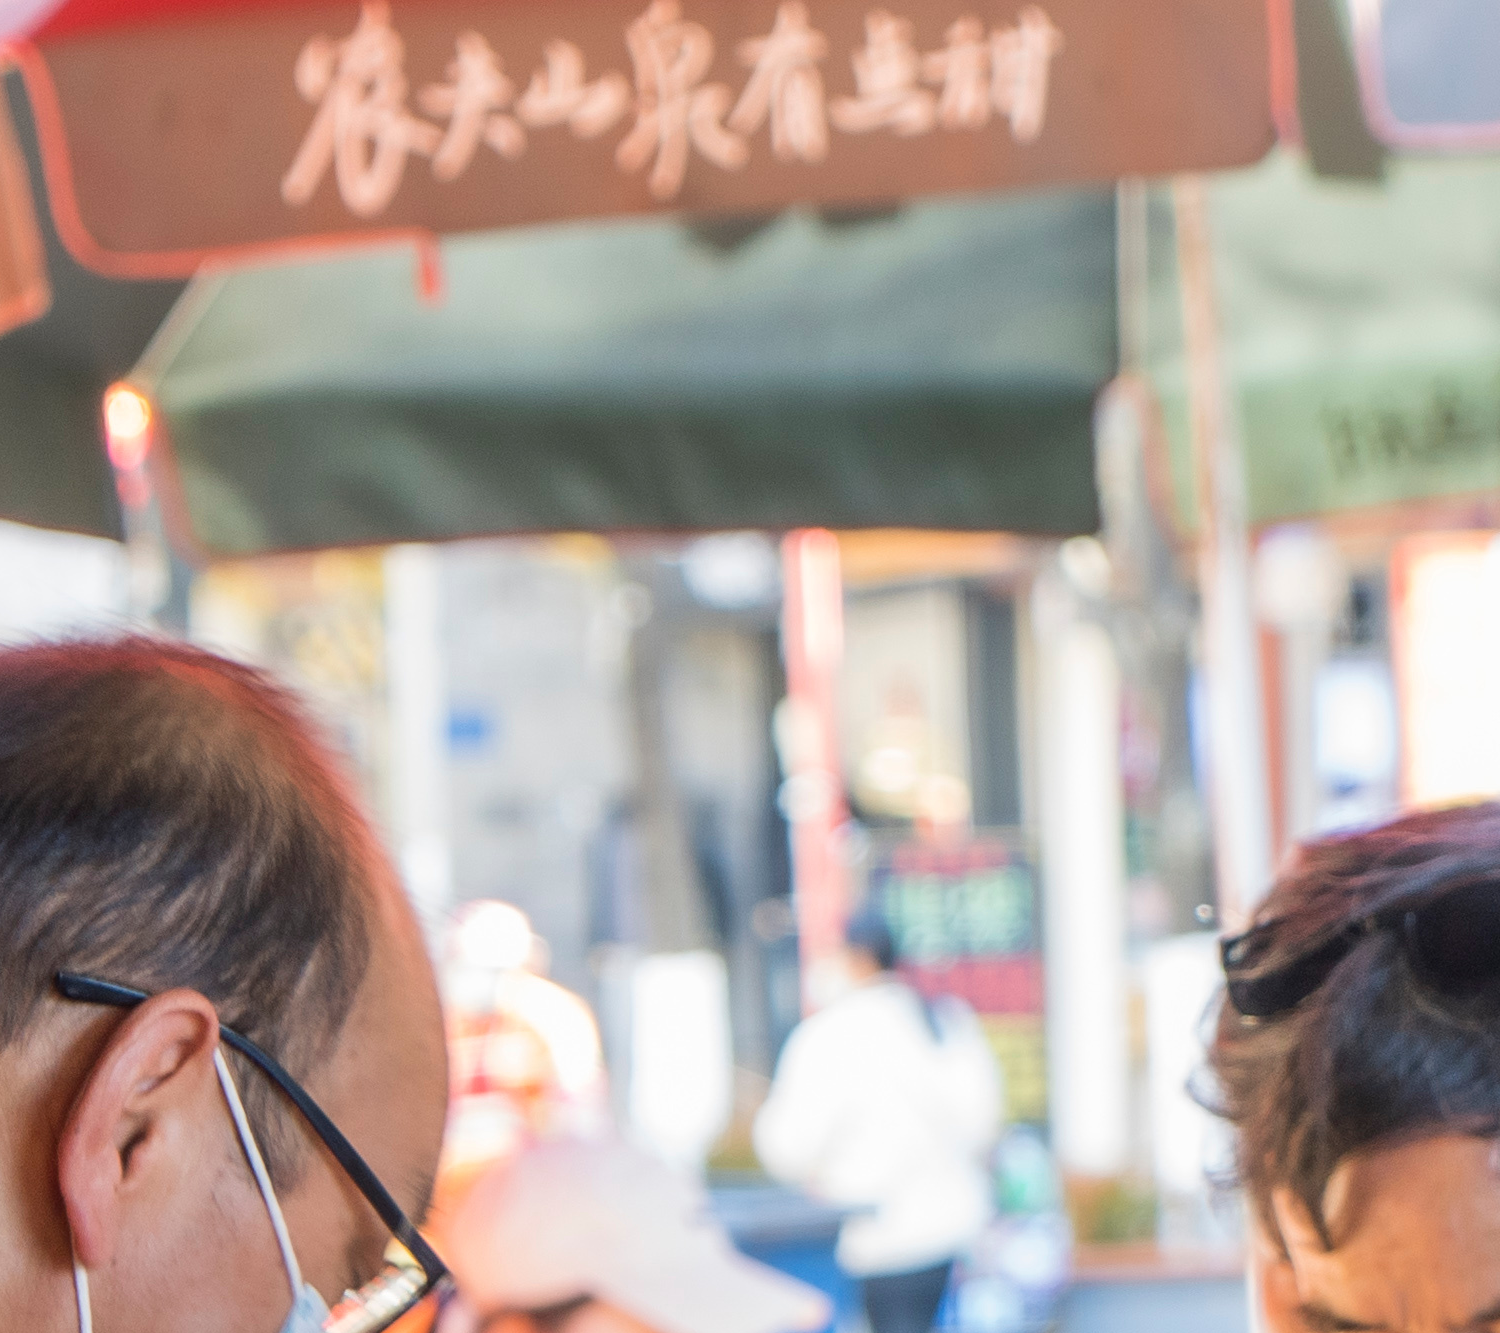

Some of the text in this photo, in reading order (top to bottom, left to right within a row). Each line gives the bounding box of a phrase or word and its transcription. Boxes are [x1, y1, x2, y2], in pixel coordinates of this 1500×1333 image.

[281, 0, 1062, 216] 农夫山泉有点甜
